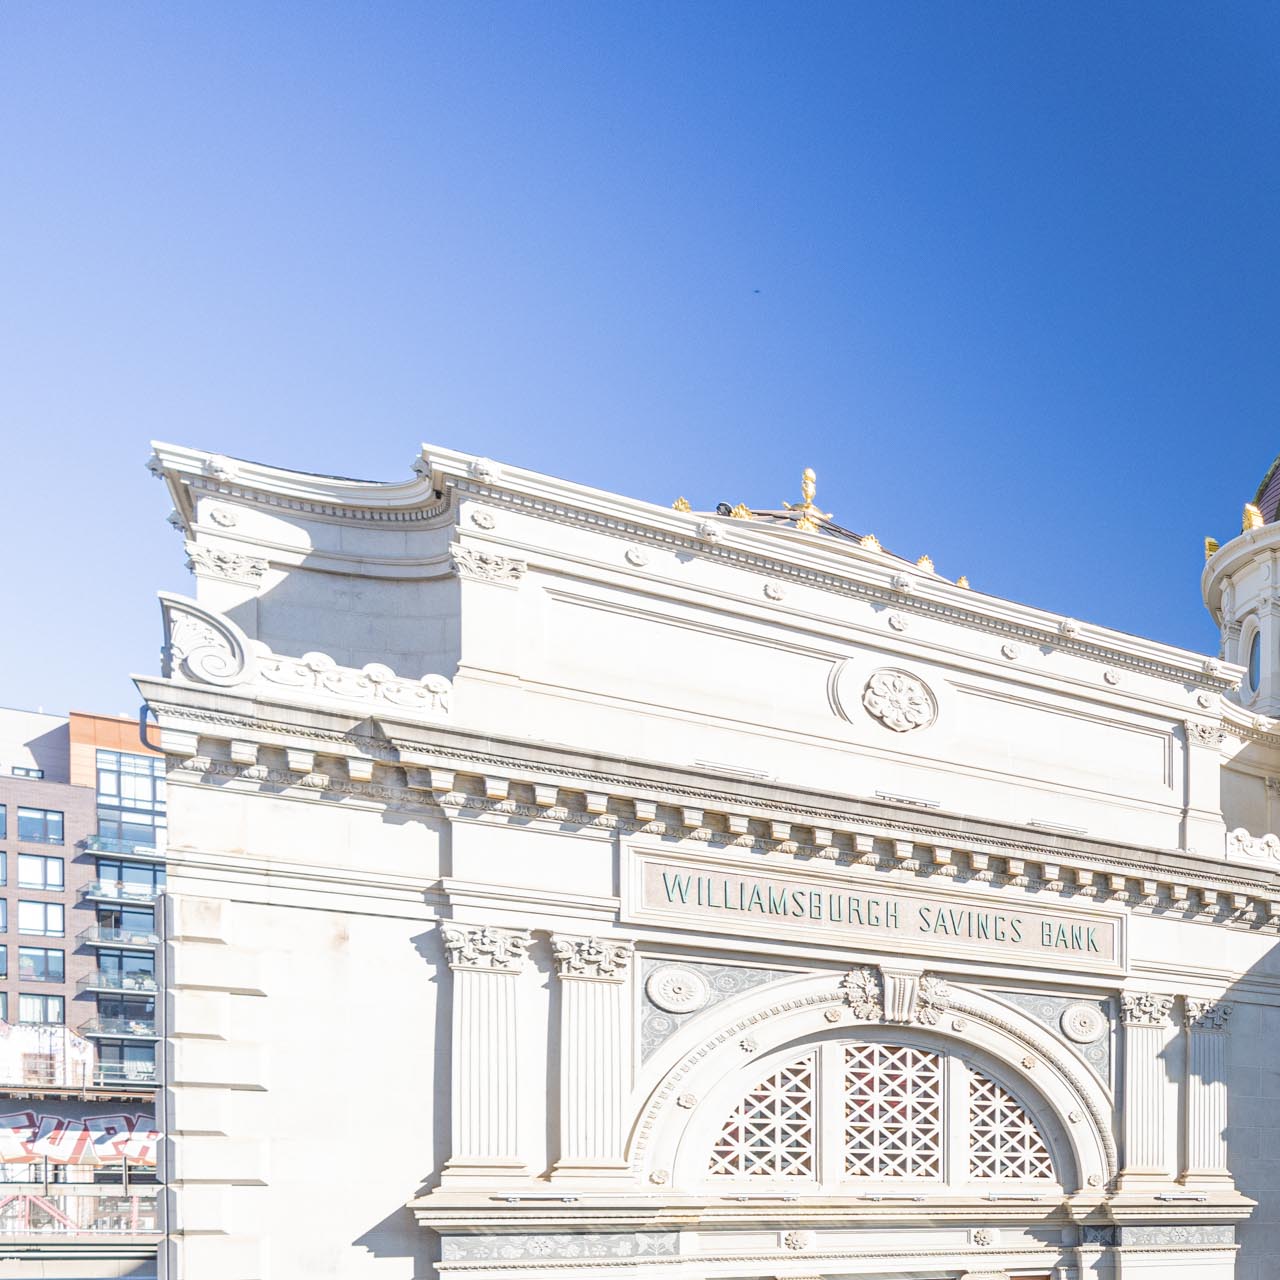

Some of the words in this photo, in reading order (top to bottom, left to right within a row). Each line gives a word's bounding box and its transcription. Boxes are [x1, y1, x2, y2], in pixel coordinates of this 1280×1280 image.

[662, 872, 900, 929] WILLIAMSBURGH
[918, 906, 1023, 943] SAVINGS
[1041, 920, 1099, 952] BANK
